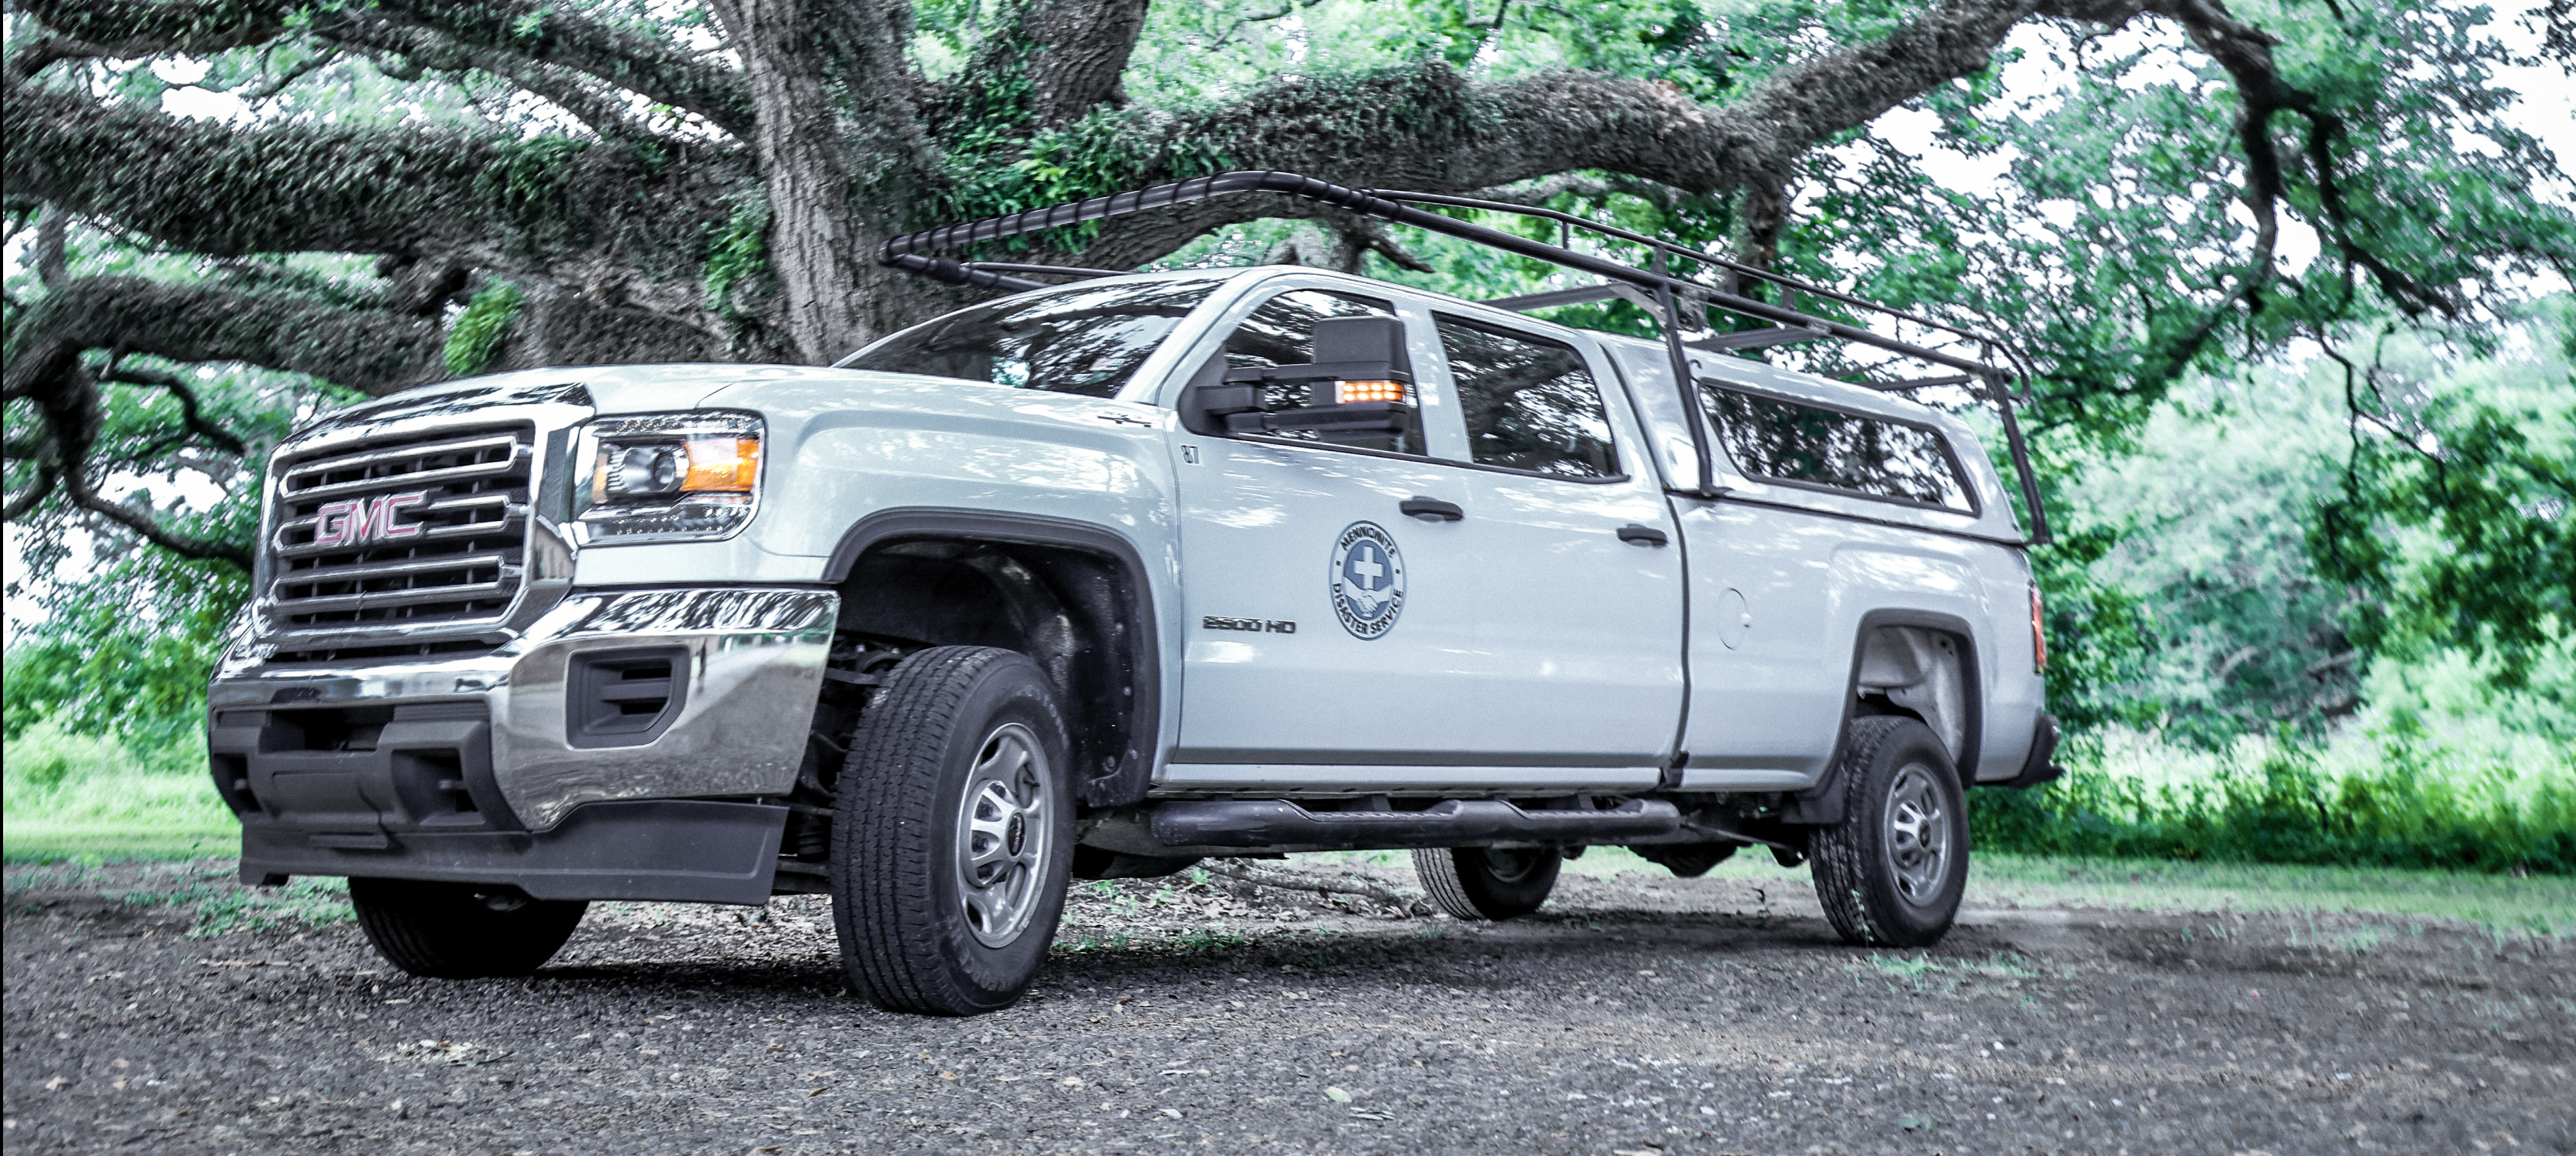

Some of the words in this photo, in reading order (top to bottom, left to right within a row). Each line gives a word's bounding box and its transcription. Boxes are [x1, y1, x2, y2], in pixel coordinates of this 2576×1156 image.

[1180, 444, 1200, 464] 87
[315, 490, 427, 546] GMC
[1340, 526, 1396, 559] MENNONITE
[1203, 616, 1263, 631] 2500
[1265, 620, 1296, 633] HD
[1333, 583, 1369, 635] DISASTER
[1370, 589, 1403, 634] SERVICE
